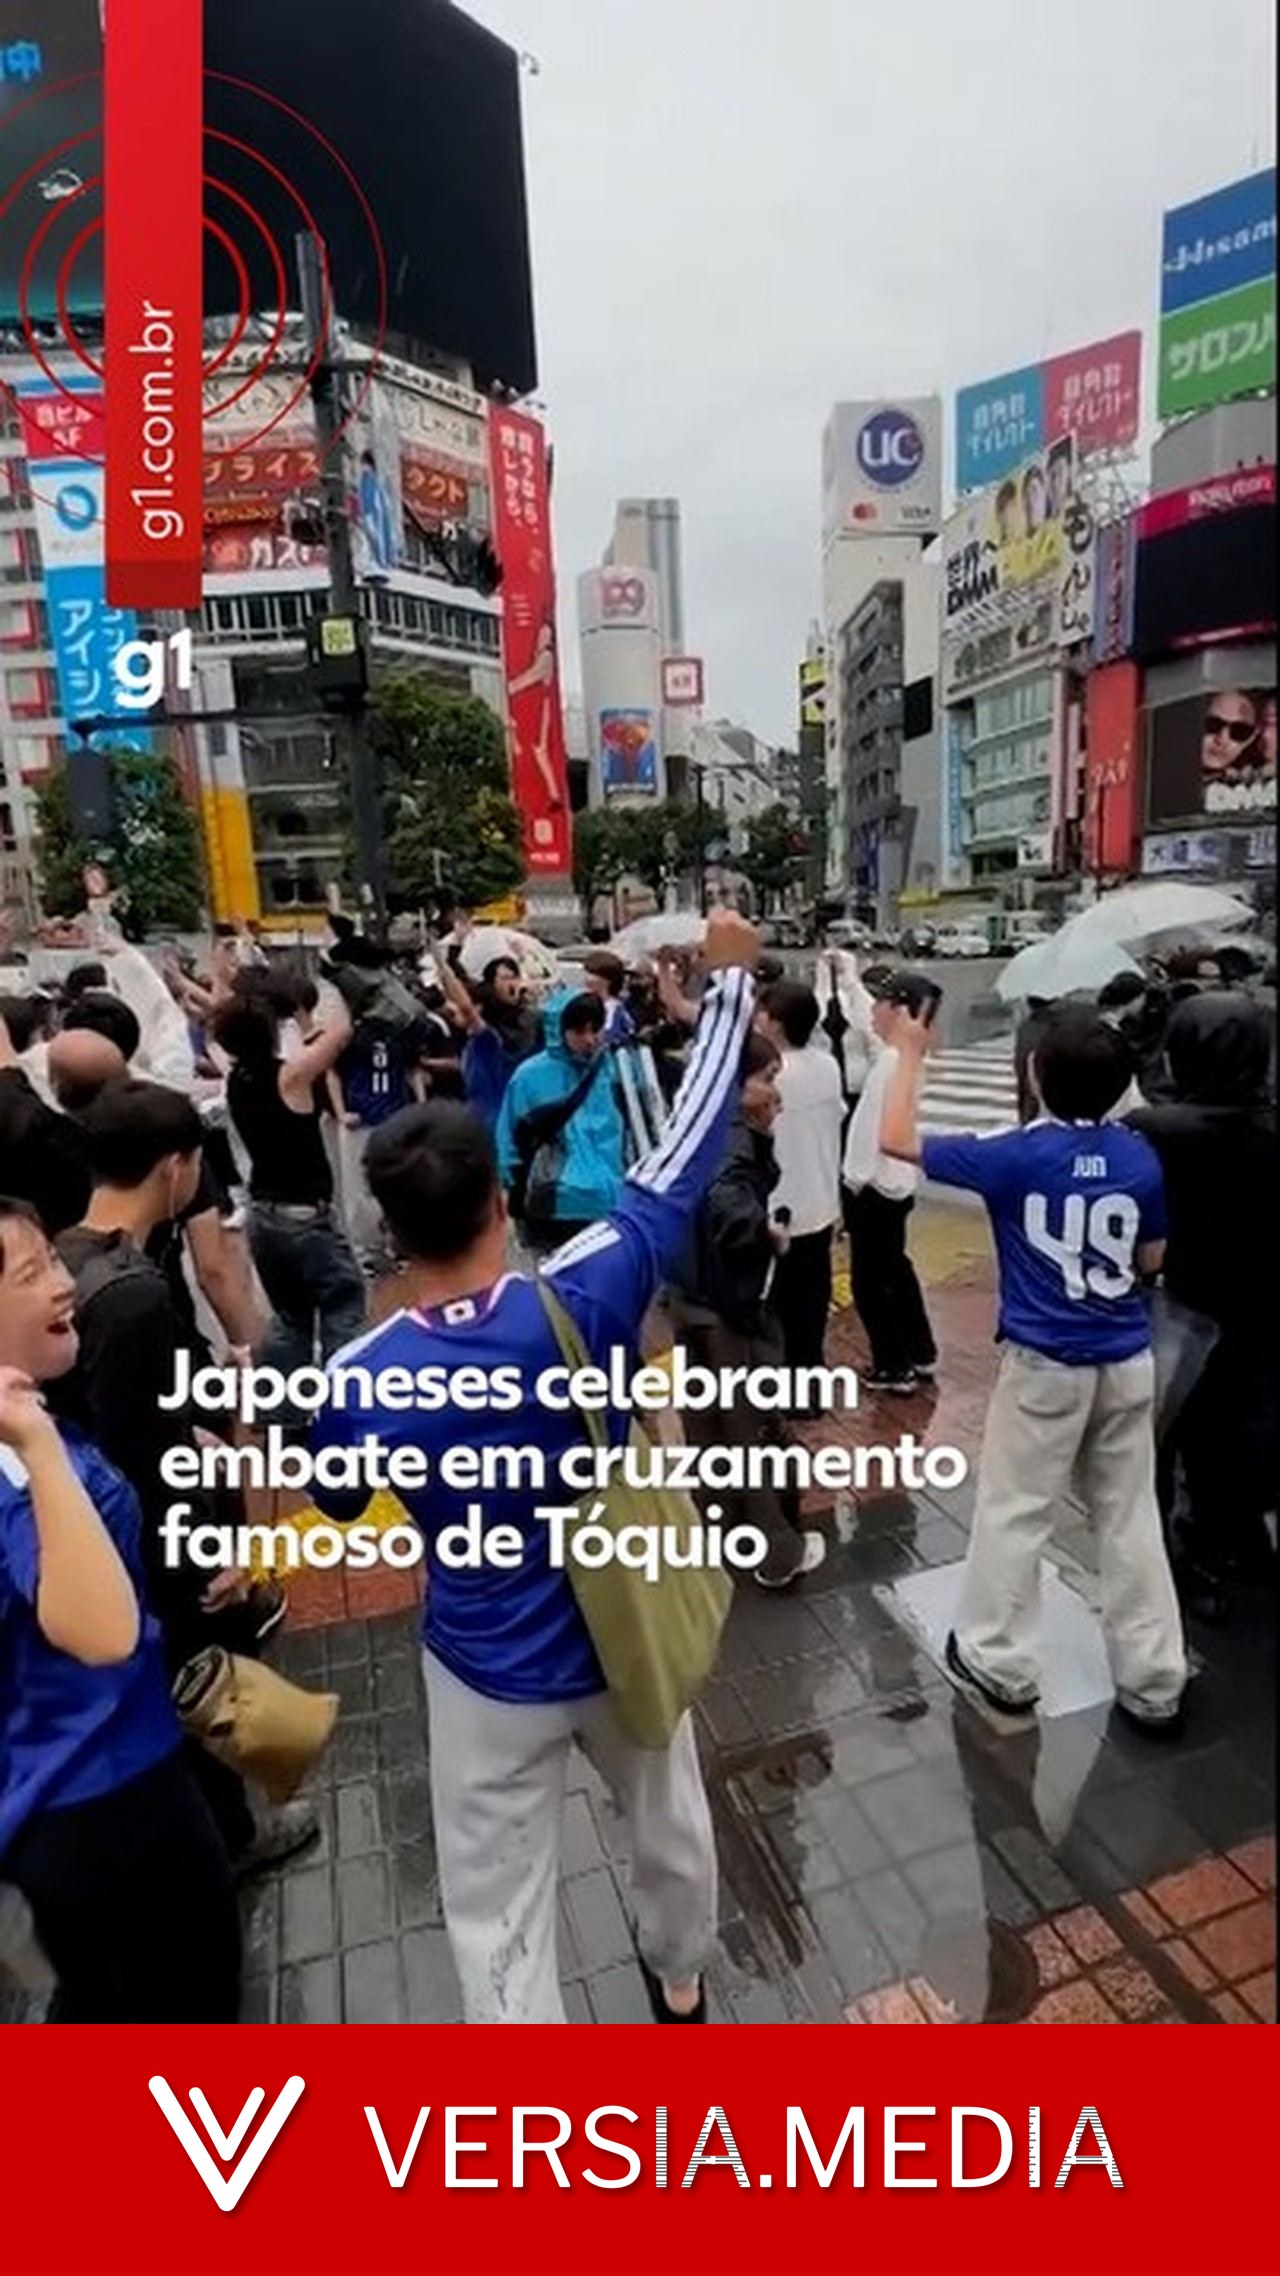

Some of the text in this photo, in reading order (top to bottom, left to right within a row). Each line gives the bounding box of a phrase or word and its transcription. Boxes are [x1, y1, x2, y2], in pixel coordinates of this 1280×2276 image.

[0, 41, 41, 81] 中
[860, 428, 919, 466] UC
[59, 600, 104, 718] アイシ
[1023, 1192, 1142, 1300] 49
